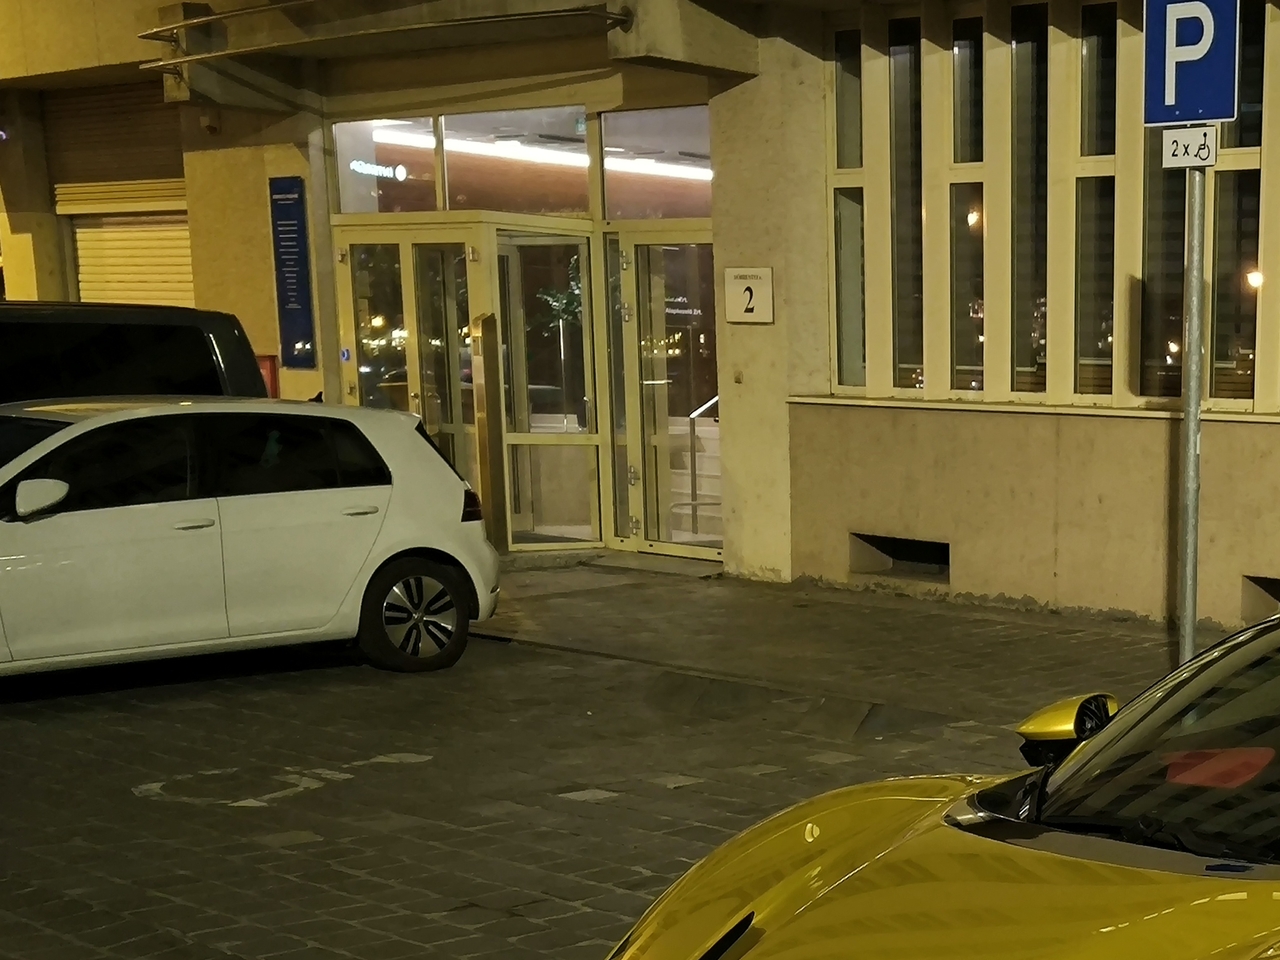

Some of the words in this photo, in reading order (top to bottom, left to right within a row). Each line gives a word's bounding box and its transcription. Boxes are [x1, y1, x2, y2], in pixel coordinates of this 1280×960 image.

[1165, 1, 1215, 105] P
[1171, 140, 1179, 157] 2
[1183, 144, 1190, 157] x
[743, 286, 755, 313] 2
